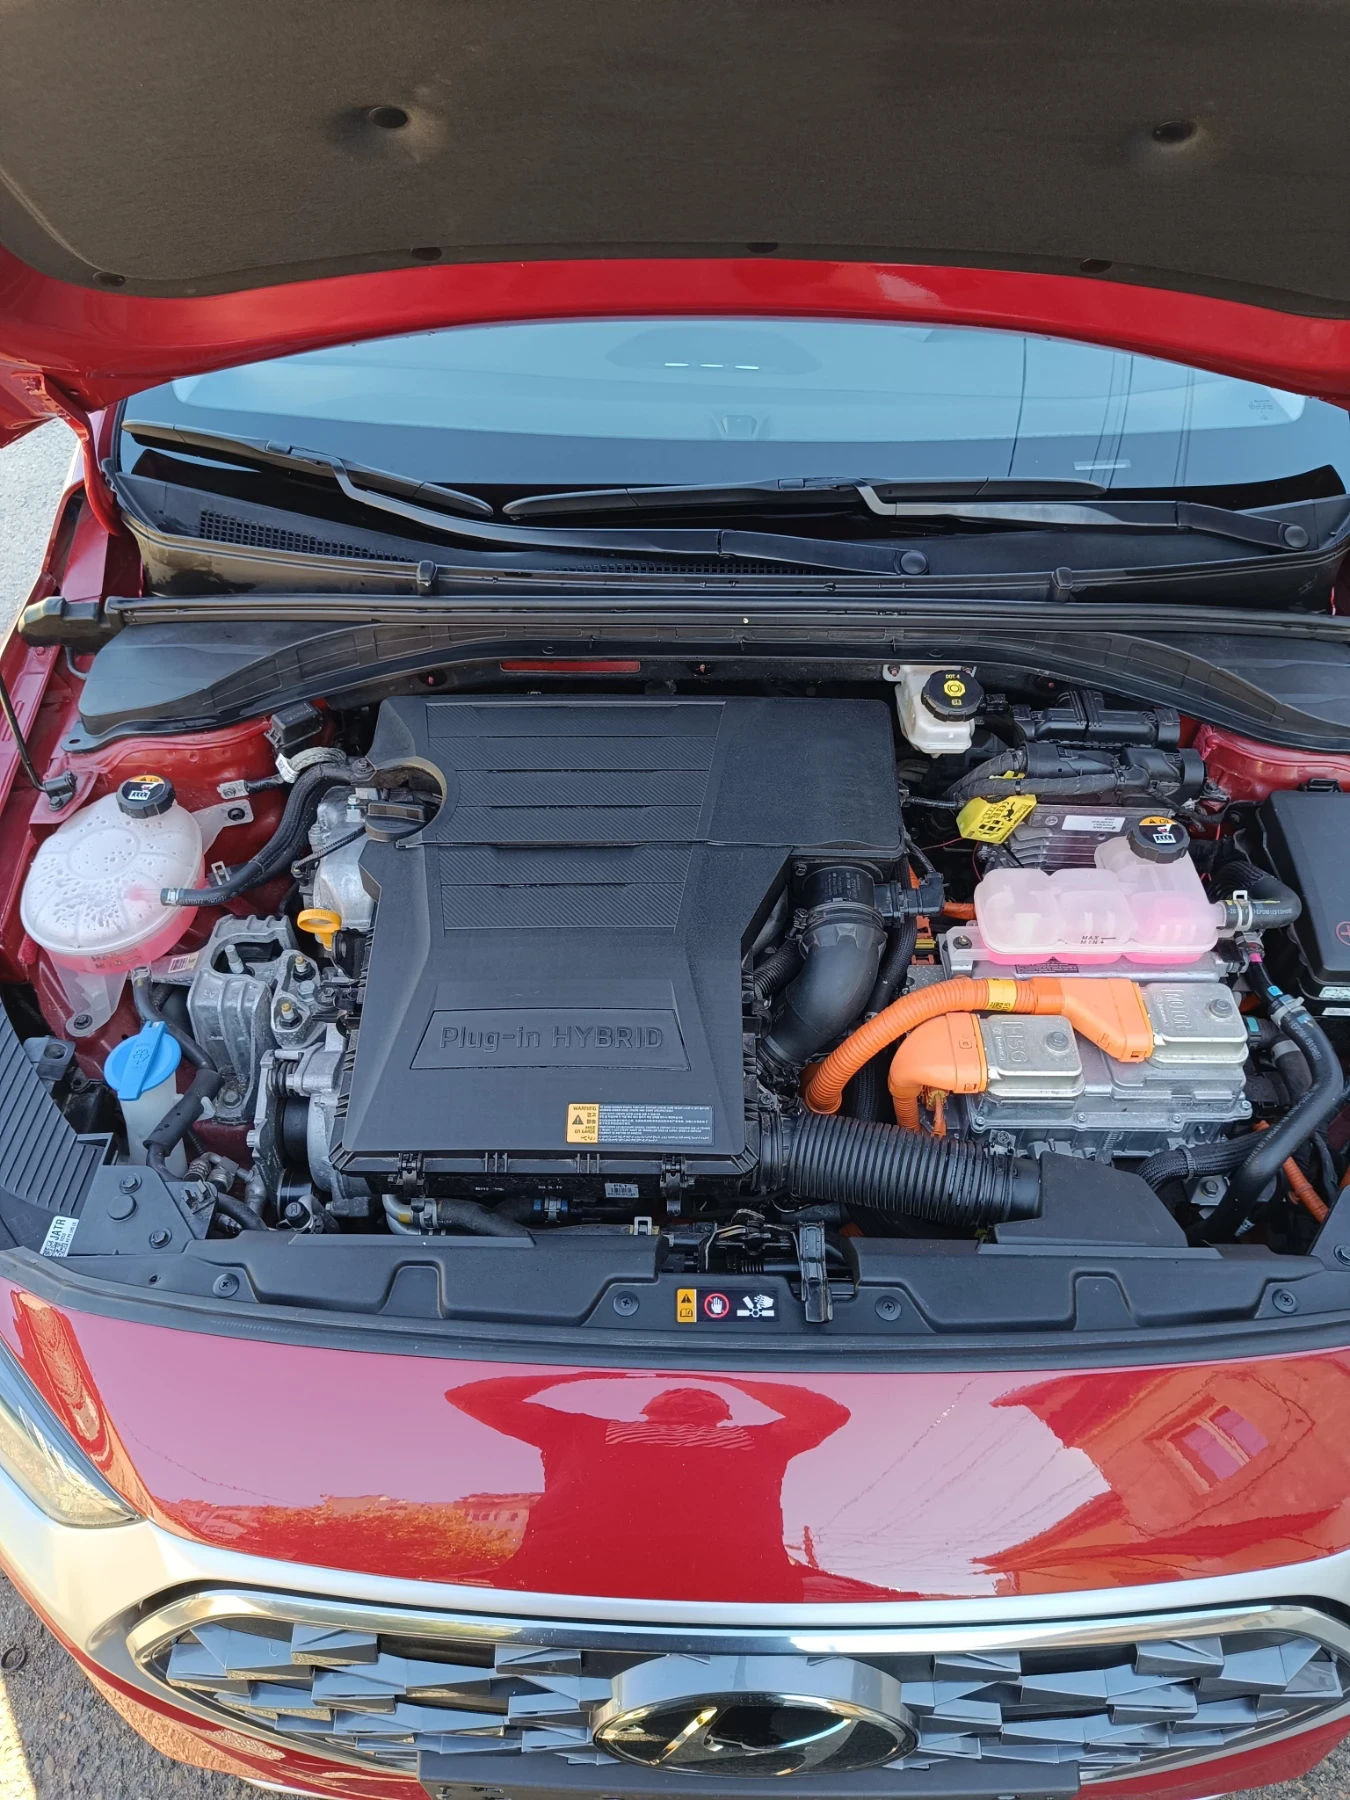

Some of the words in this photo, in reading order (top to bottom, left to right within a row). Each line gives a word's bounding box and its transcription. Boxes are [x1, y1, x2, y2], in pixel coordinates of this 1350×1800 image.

[1164, 993, 1193, 1029] MOTOR
[440, 1026, 541, 1053] Plug-in
[551, 1026, 664, 1048] HYBRID
[1005, 1026, 1029, 1062] HSG
[50, 1219, 66, 1240] JATR
